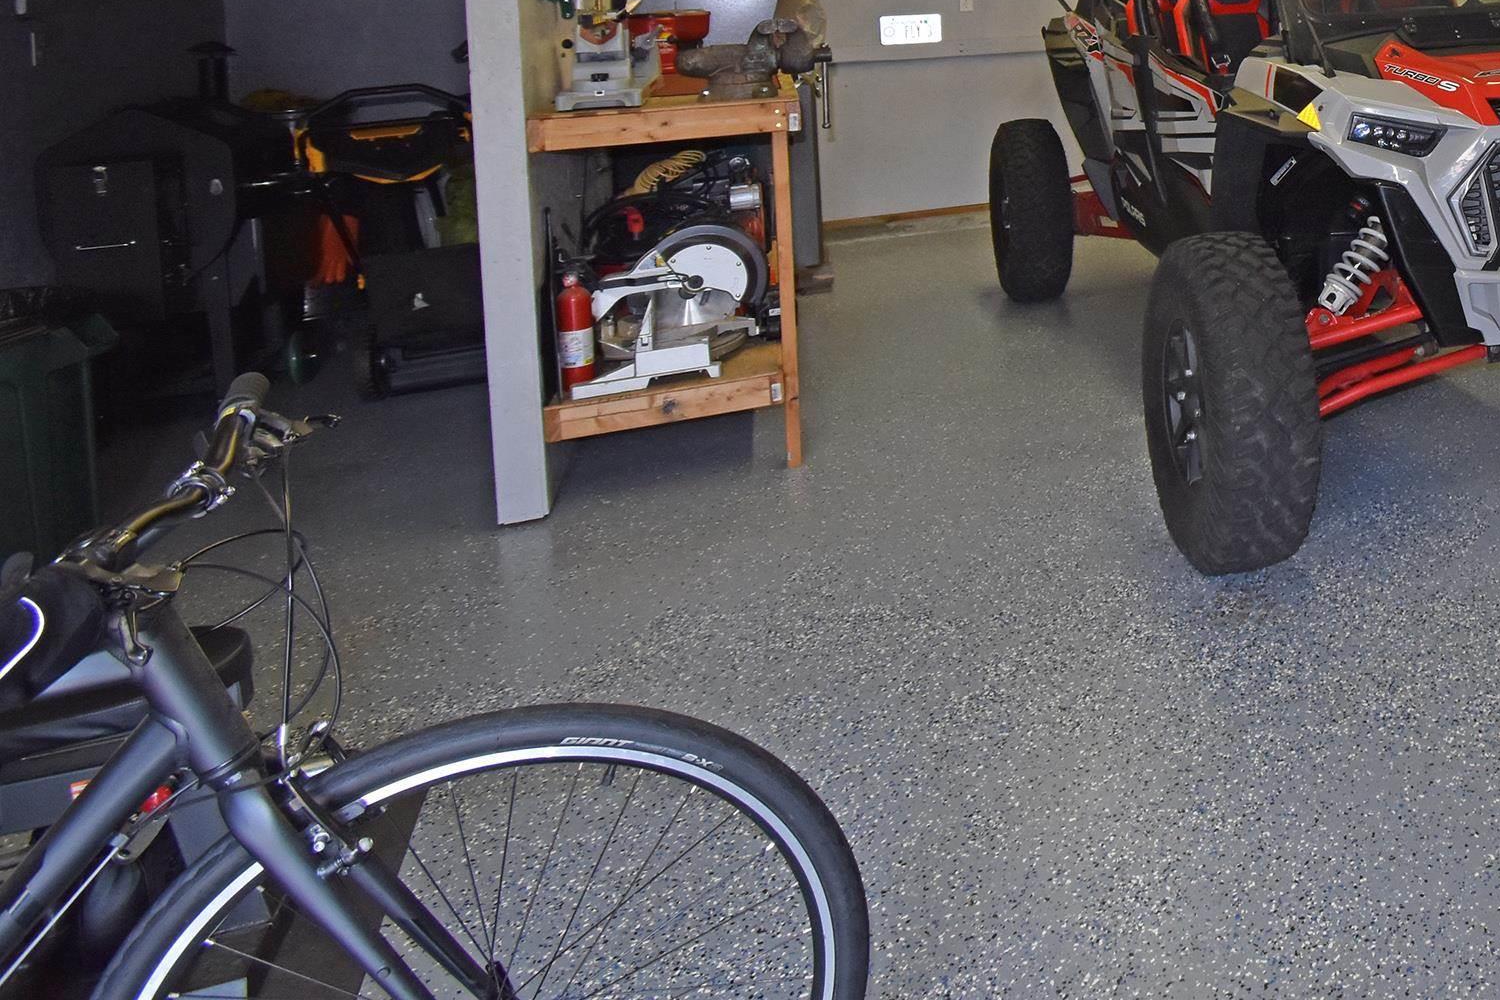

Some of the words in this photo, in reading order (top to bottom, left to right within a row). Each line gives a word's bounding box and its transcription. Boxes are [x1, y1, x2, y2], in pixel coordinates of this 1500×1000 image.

[1384, 63, 1441, 85] TURBO
[1437, 80, 1460, 93] S
[559, 736, 635, 747] GIANT
